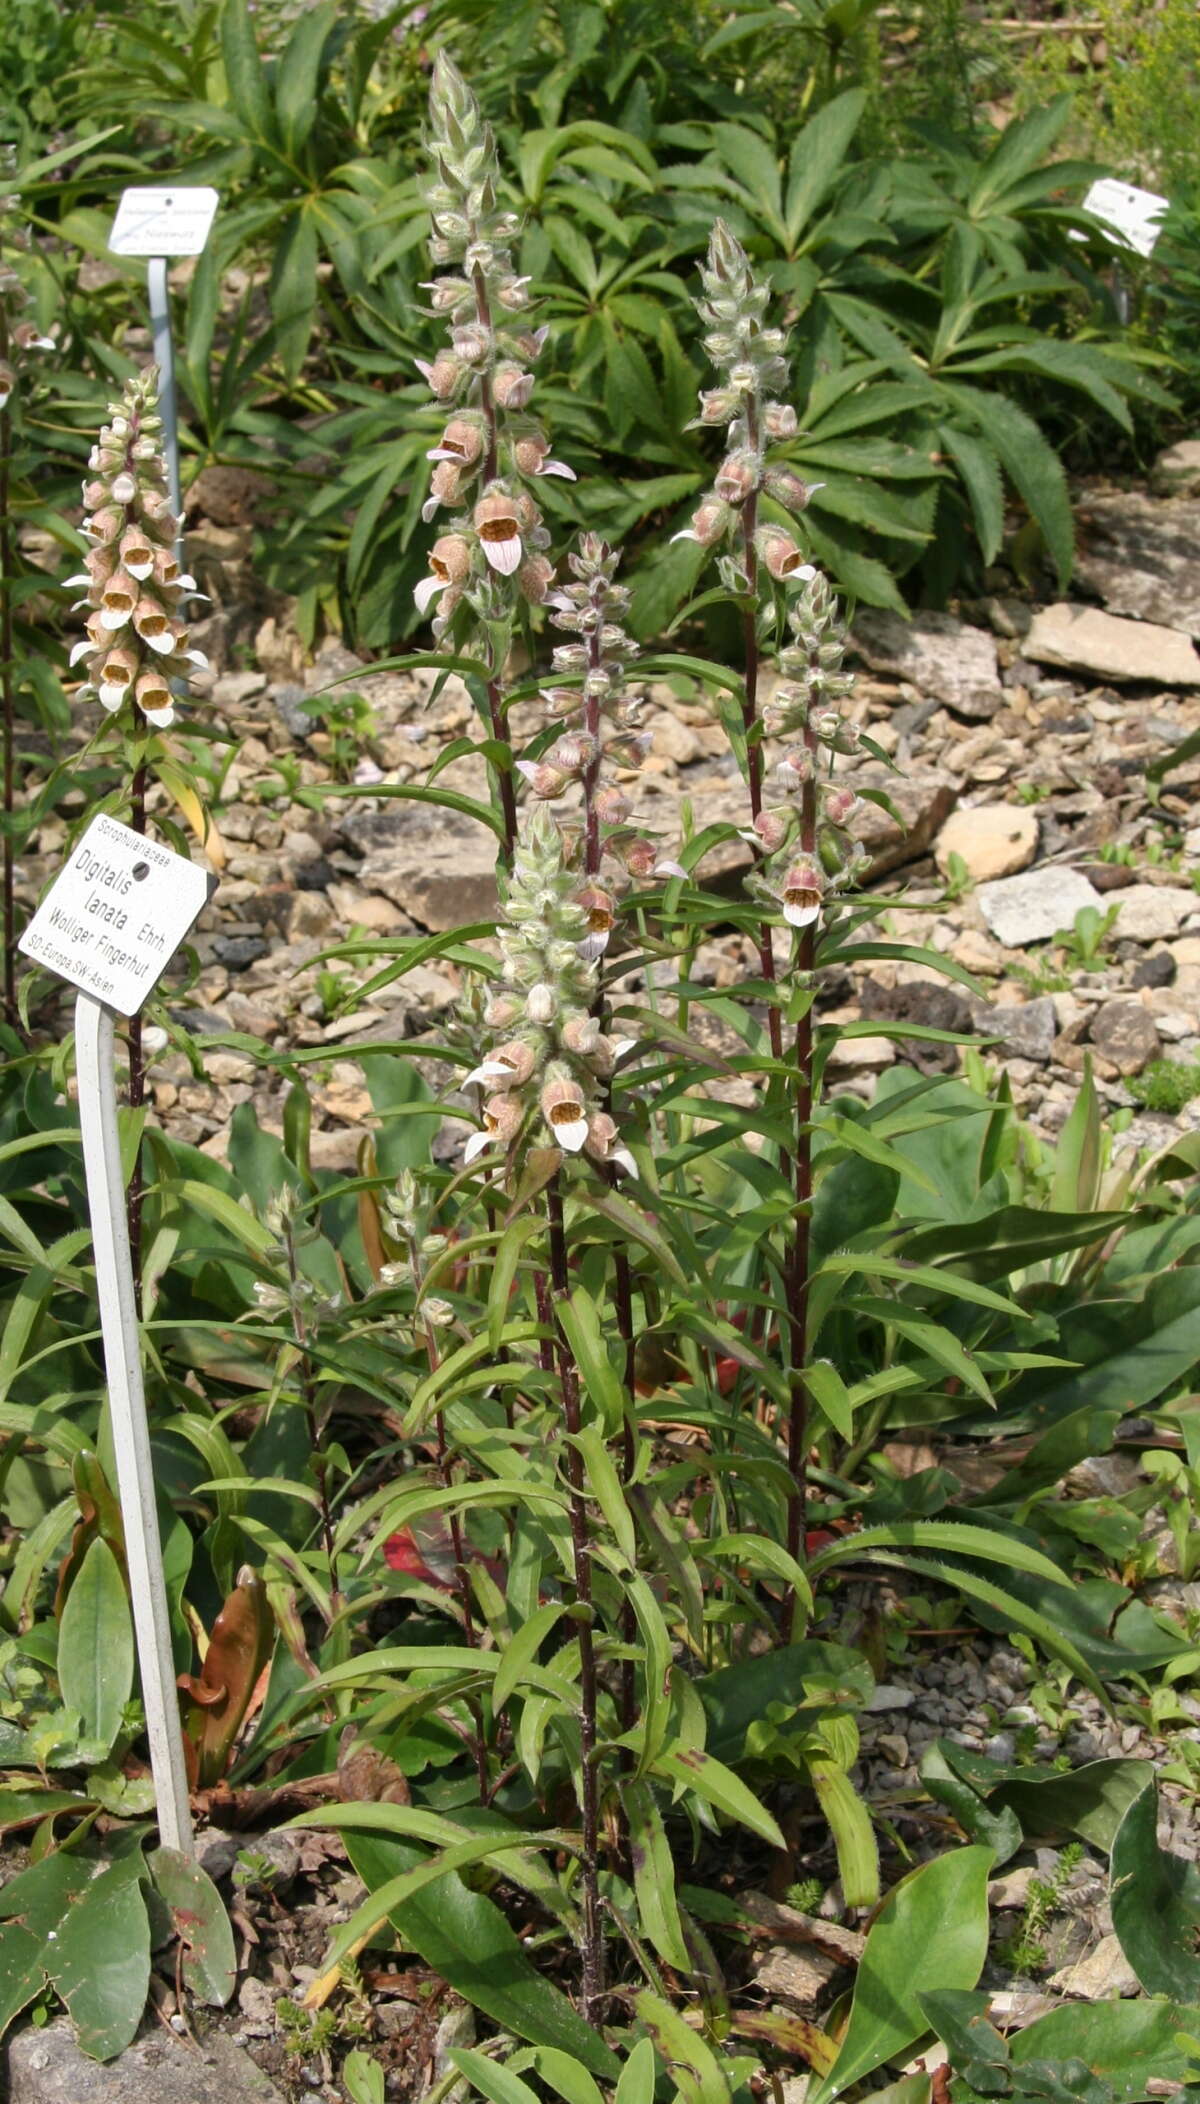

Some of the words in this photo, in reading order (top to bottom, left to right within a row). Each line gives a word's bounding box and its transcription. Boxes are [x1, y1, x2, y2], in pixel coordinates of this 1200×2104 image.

[98, 819, 170, 867] Scrophulariaceae
[75, 849, 132, 894] Digitalis
[49, 907, 94, 943] Wolliger
[96, 935, 150, 977] Fingerhut
[84, 890, 128, 929] lanata
[137, 923, 166, 952] Ehrh.
